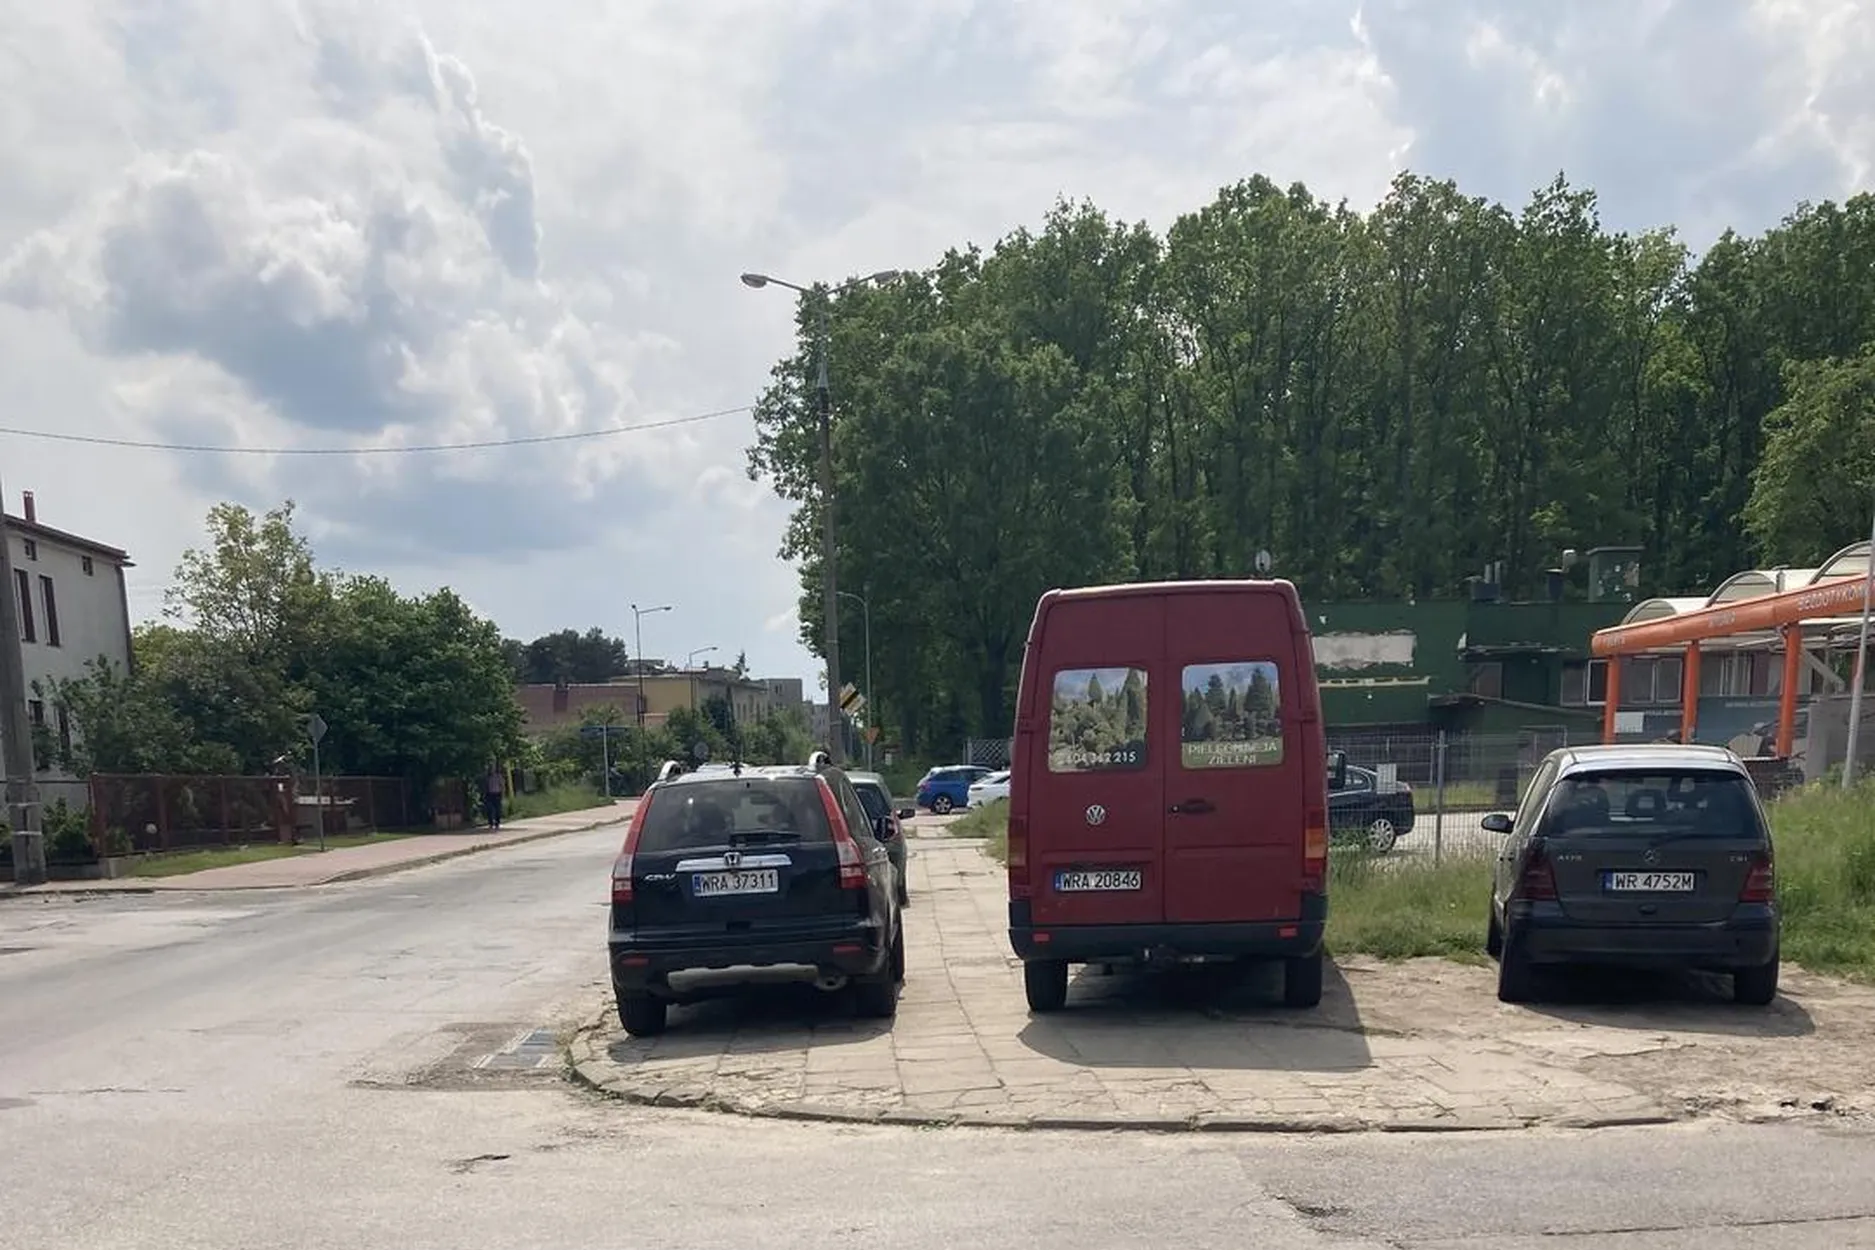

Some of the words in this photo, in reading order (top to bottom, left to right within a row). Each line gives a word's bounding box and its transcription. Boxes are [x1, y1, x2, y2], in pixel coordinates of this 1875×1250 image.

[701, 874, 729, 893] WRA
[733, 872, 774, 890] 37311
[1063, 874, 1090, 889] WRA
[1095, 872, 1139, 888] 20846
[1615, 874, 1637, 889] WR
[1642, 874, 1692, 889] 4752M
